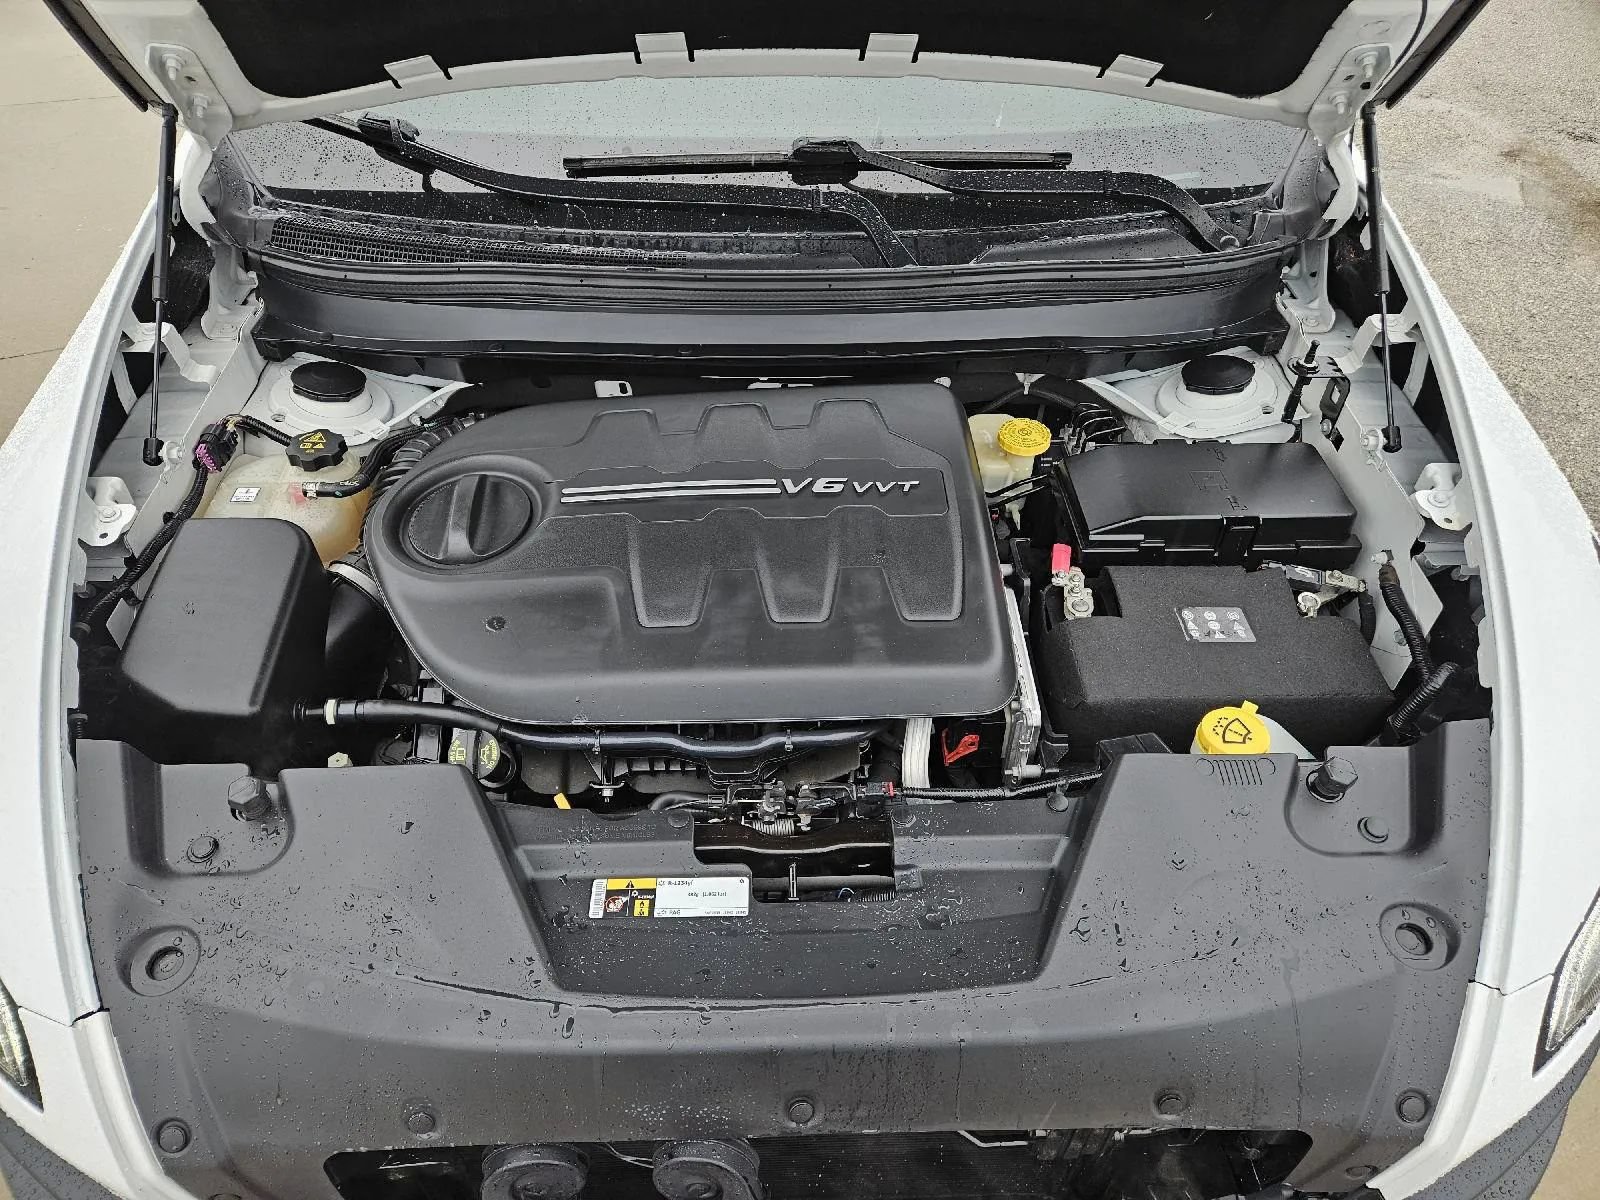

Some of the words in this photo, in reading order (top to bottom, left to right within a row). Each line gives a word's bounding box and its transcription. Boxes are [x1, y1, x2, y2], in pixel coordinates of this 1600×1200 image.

[781, 477, 848, 494] V6
[852, 480, 920, 493] VVT
[486, 760, 495, 769] OIL
